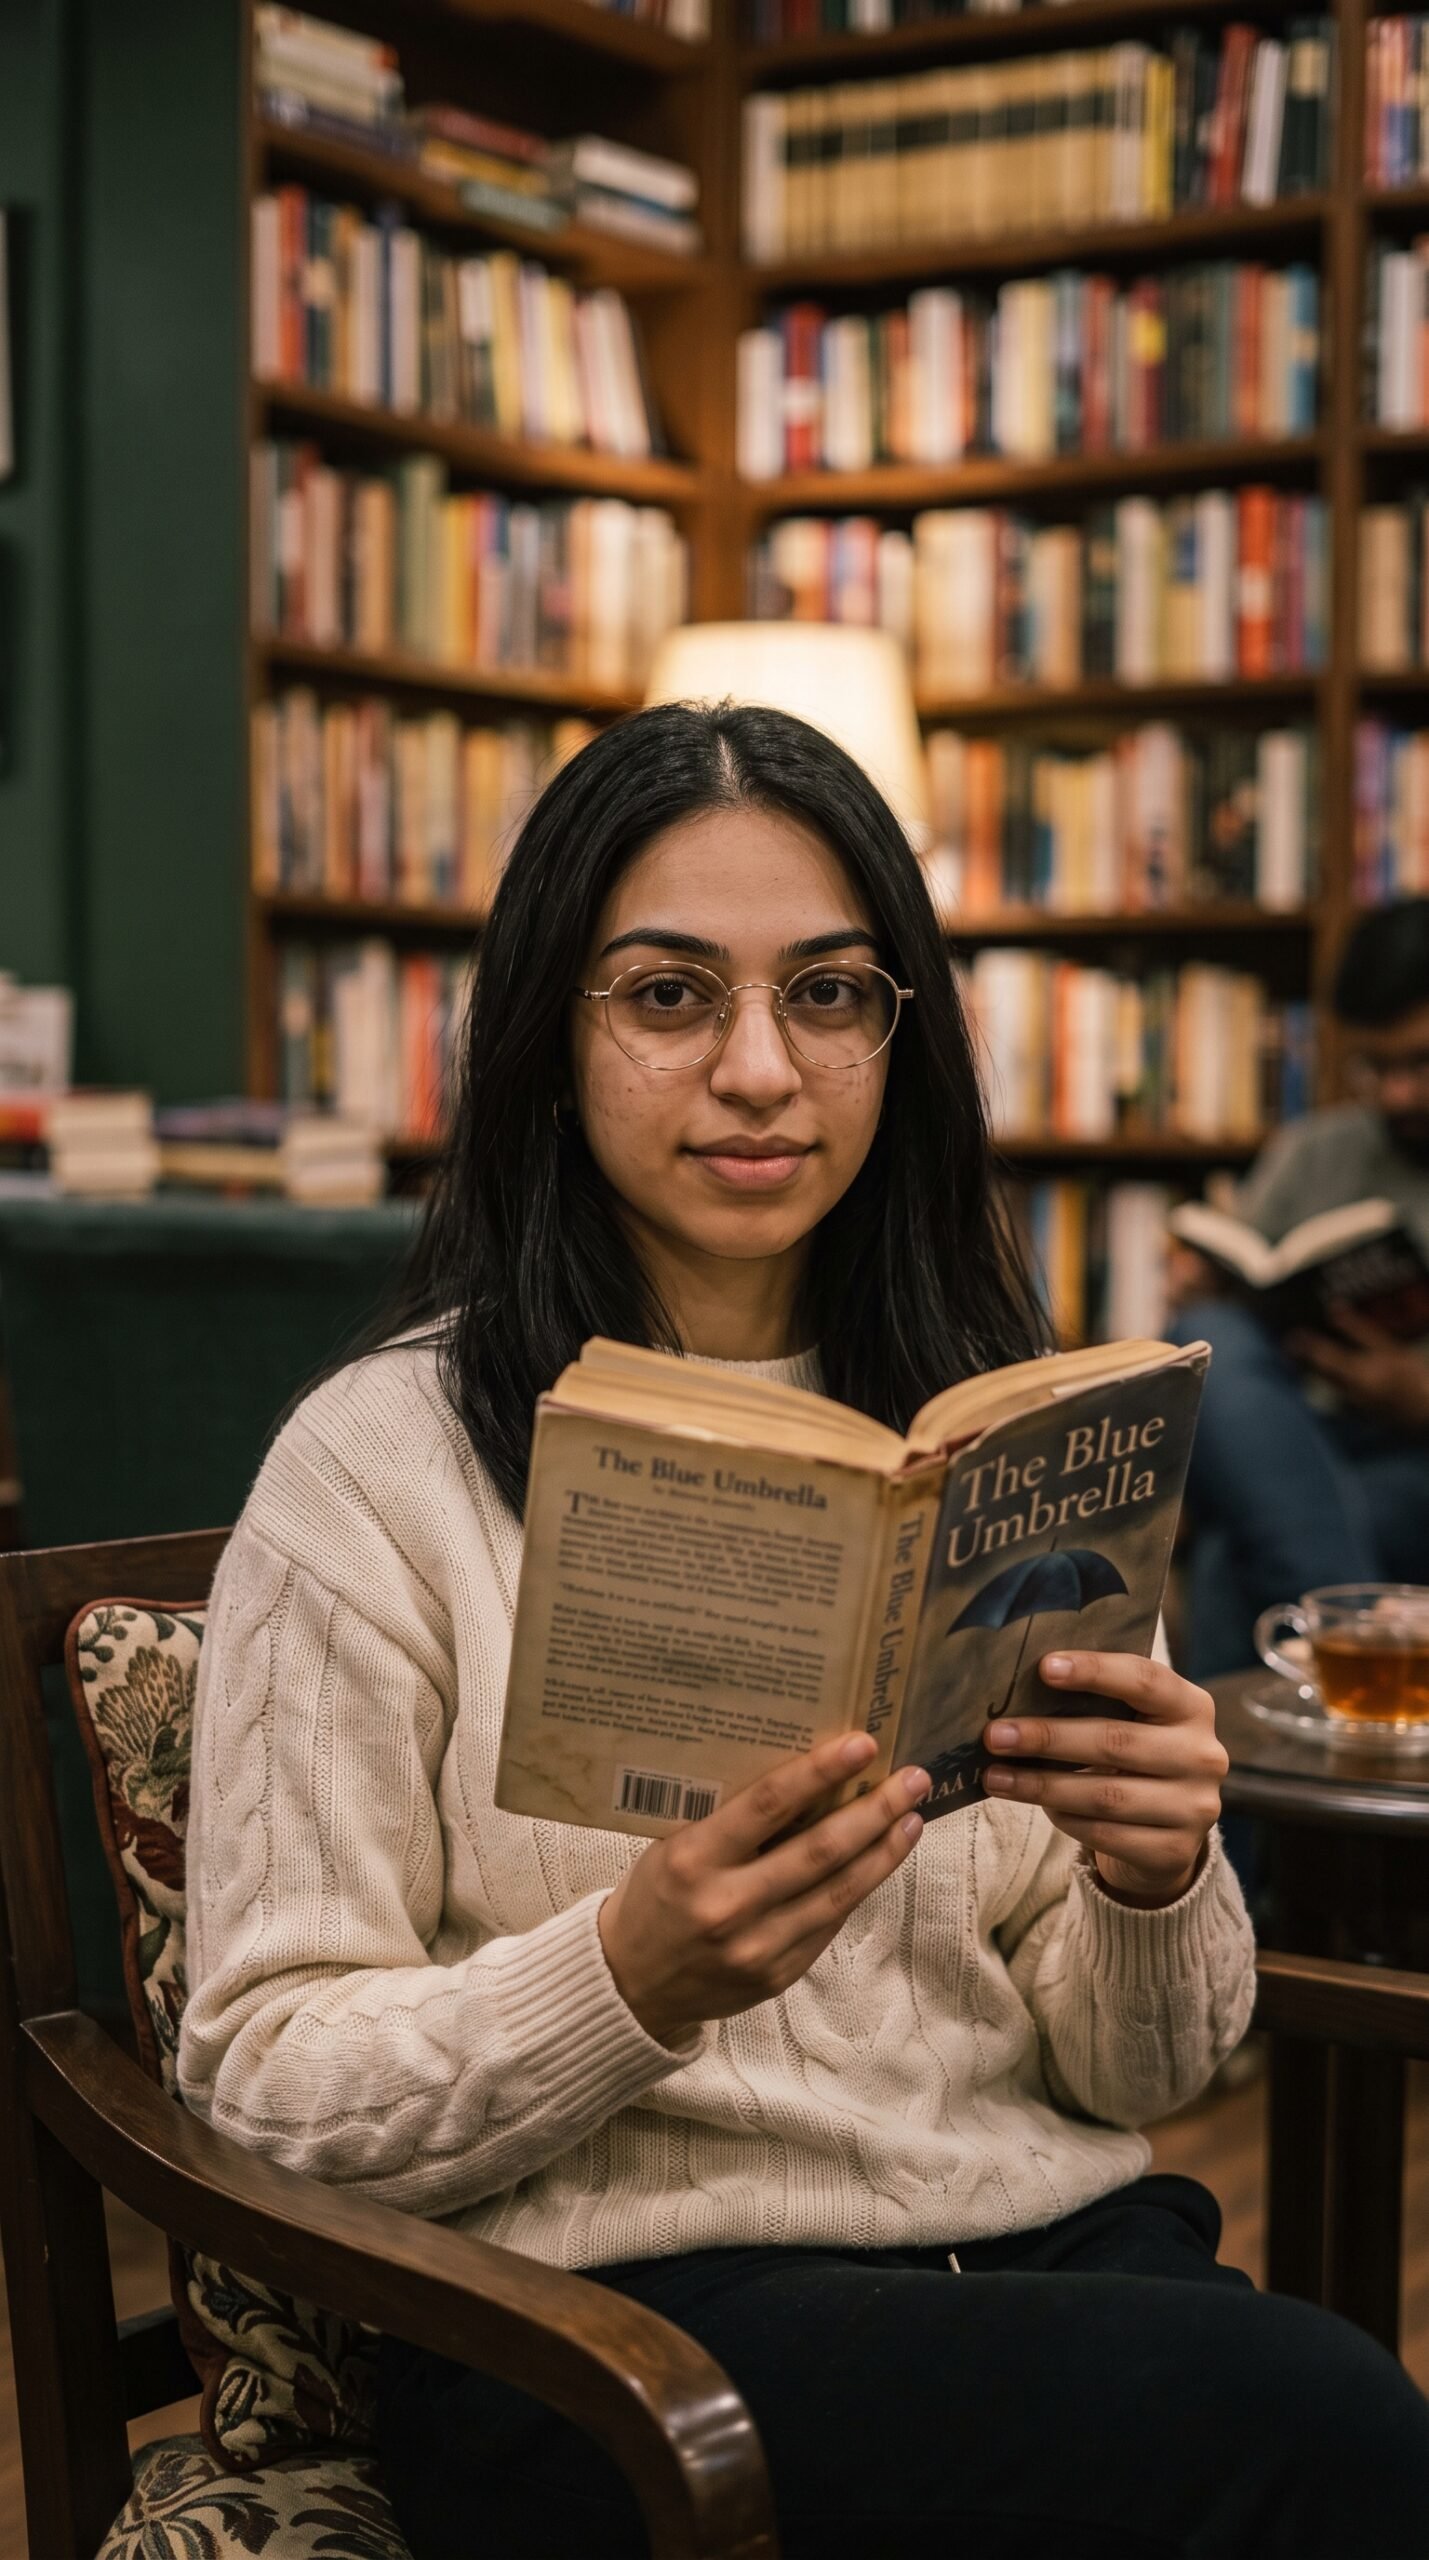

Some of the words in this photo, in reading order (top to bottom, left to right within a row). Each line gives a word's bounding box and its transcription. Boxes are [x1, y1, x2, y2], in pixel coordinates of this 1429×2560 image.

[593, 1445, 643, 1477] The
[651, 1456, 706, 1487] Blue
[713, 1468, 828, 1510] Umbrella
[960, 1453, 1047, 1514] The
[1059, 1415, 1165, 1475] Blue
[895, 1512, 925, 1564] The
[947, 1461, 1155, 1568] Umbrella
[884, 1568, 915, 1623] Blue
[866, 1628, 903, 1735] Umbrella
